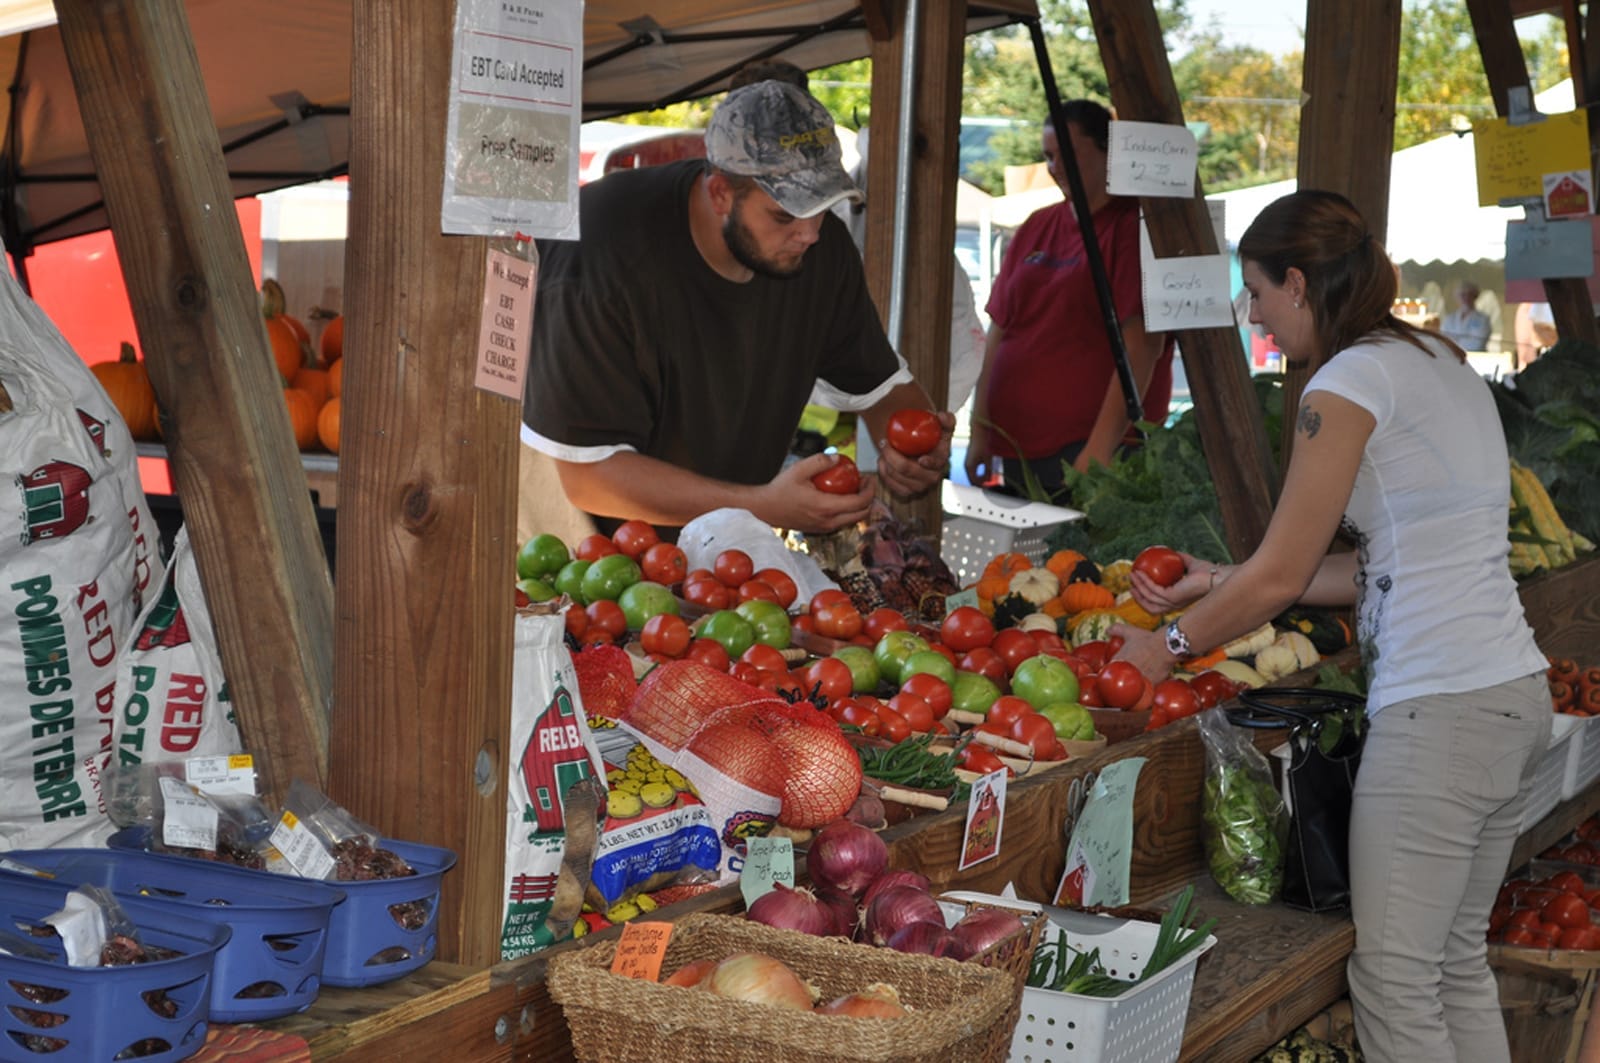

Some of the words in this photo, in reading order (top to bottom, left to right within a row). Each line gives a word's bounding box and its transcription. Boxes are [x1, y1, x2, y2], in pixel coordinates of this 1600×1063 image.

[471, 56, 492, 77] EBT
[494, 59, 517, 81] Card
[520, 63, 564, 91] Accepted
[481, 135, 506, 155] Free
[509, 137, 555, 165] Samples
[493, 261, 505, 278] We
[507, 267, 529, 290] Accept
[500, 294, 514, 310] EBT
[495, 315, 515, 331] CASH
[490, 332, 516, 352] CHECK
[485, 350, 516, 371] CHARGE
[10, 574, 73, 697] POMMES
[76, 578, 116, 668] RED
[29, 698, 75, 738] DE
[160, 672, 207, 753] RED
[32, 736, 87, 823] TERRE
[83, 756, 107, 815] BRAND
[608, 836, 626, 847] LBS.
[626, 828, 643, 840] NET
[644, 823, 663, 835] WT.
[771, 866, 793, 881] each
[509, 913, 526, 925] NET
[520, 934, 536, 946] KG
